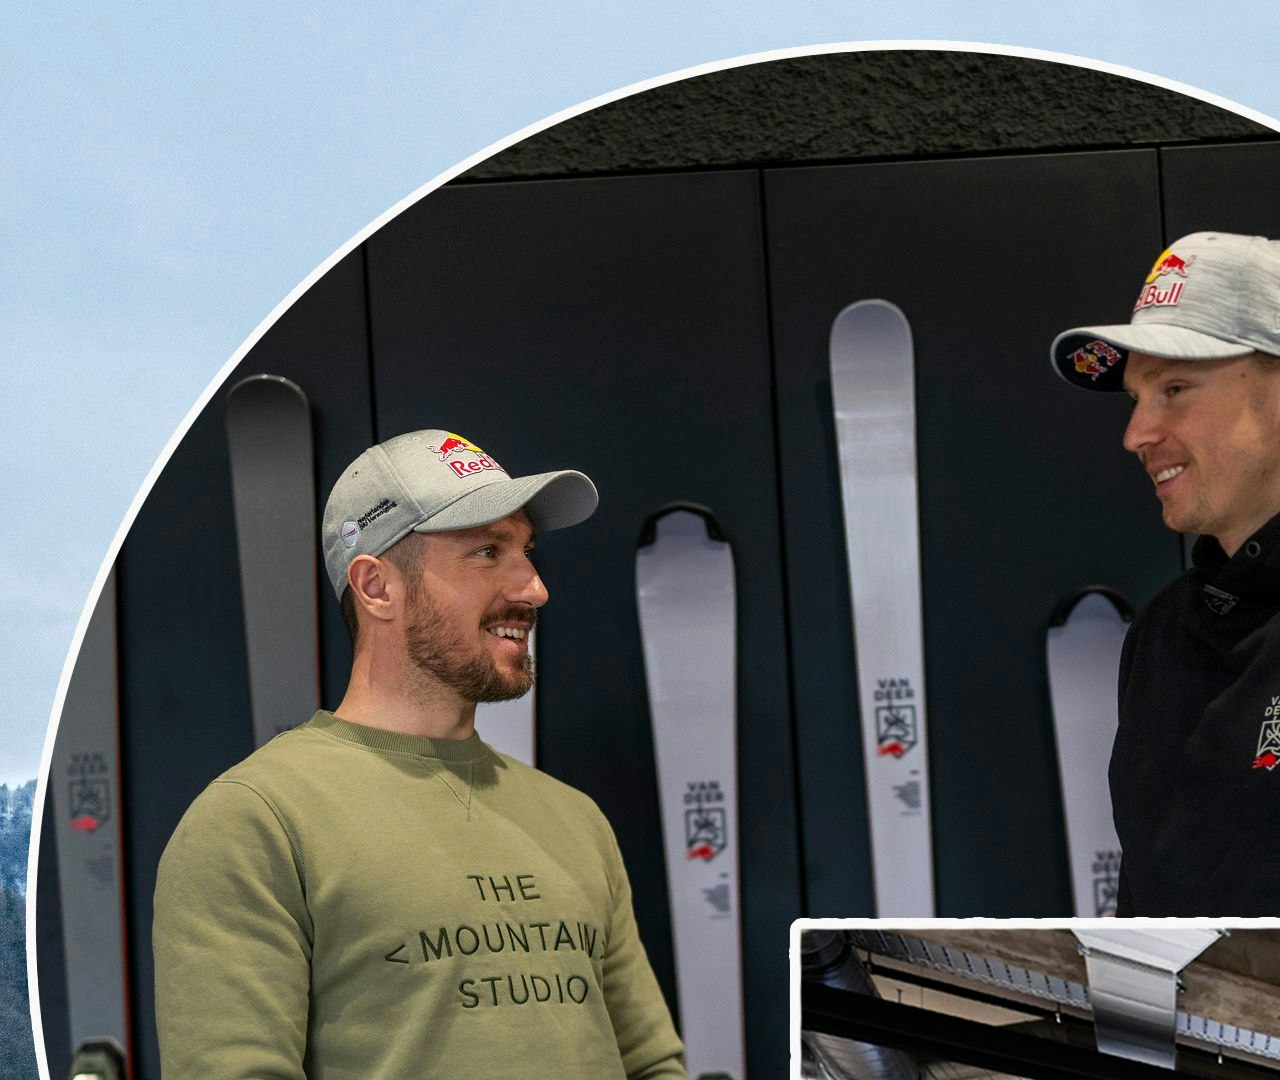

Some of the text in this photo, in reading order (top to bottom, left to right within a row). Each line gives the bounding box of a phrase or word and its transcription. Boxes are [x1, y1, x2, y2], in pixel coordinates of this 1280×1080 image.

[1144, 283, 1183, 304] Bull
[450, 454, 493, 476] Red
[877, 678, 910, 689] VAN
[874, 688, 914, 701] DEER
[687, 781, 719, 792] VAN
[684, 791, 724, 804] DEER
[1092, 862, 1120, 874] DEE
[467, 874, 540, 901] THE
[419, 921, 596, 962] MOUNTAIN
[459, 974, 589, 1009] STUDIO
